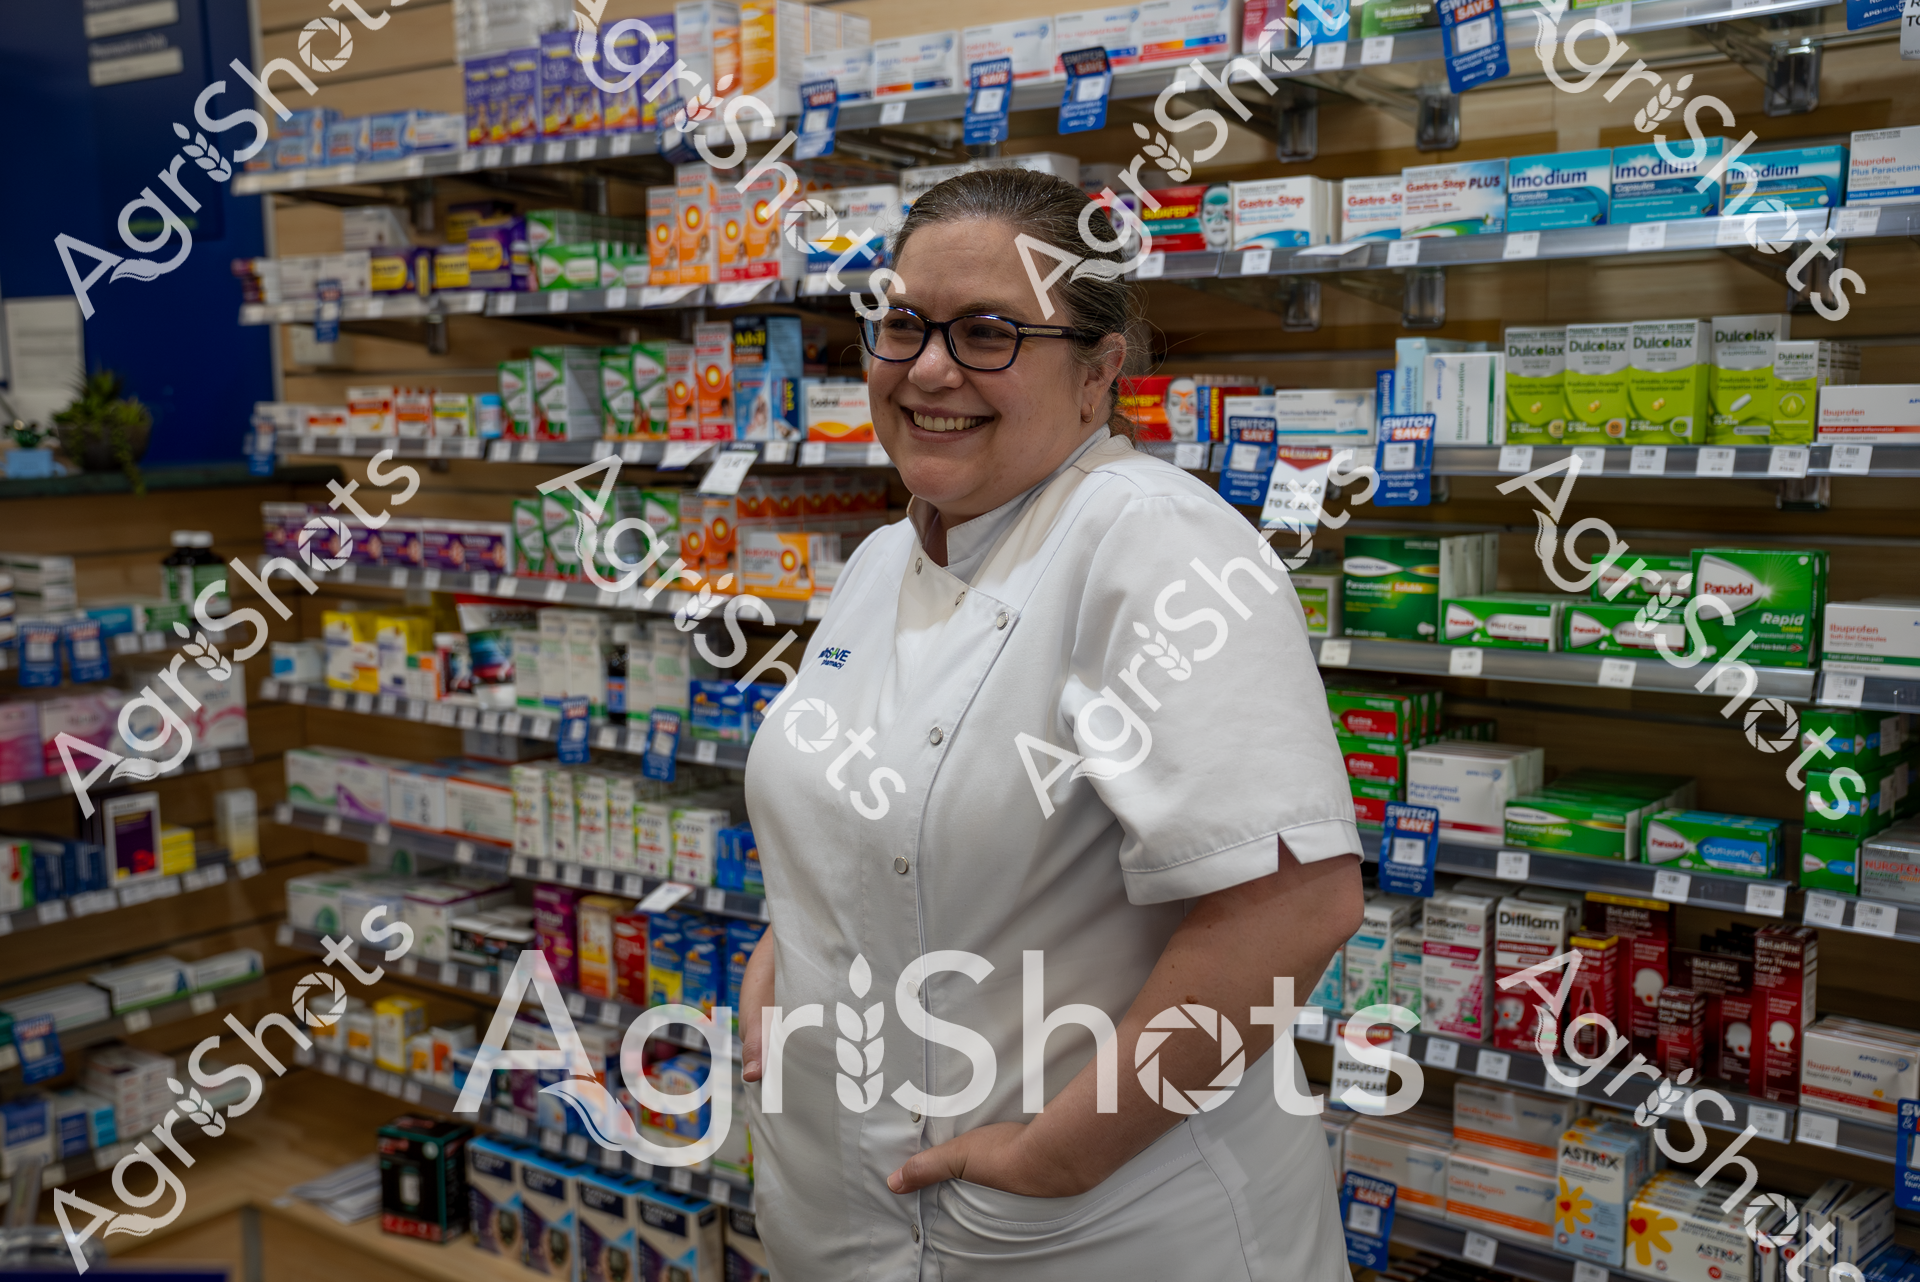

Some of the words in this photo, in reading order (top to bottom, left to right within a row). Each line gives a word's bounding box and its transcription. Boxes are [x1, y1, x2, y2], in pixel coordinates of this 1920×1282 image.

[1456, 0, 1493, 21] SAVE
[1063, 50, 1105, 66] SWITCH
[972, 59, 1010, 77] SWITCH
[1075, 61, 1105, 74] SAVE
[980, 73, 1008, 87] SAVE
[802, 80, 837, 98] SWITCH
[810, 92, 836, 107] SAVE
[1615, 157, 1697, 179] Imodium
[1852, 155, 1896, 167] Ibuprofen
[1511, 167, 1588, 189] Imodium
[1732, 164, 1799, 181] Imodium
[1851, 167, 1870, 177] Plus
[1406, 179, 1466, 193] Gastro-Stop
[1468, 174, 1500, 190] PLUS
[1615, 181, 1655, 193] Capsules
[1239, 195, 1305, 210] Gastro-Stop
[1511, 191, 1548, 202] Capsules
[1633, 336, 1692, 350] Dulcolax
[1714, 328, 1775, 343] Dulcolax
[1509, 343, 1565, 358] Dulcolax
[1569, 339, 1626, 353] Dulcolax
[1778, 351, 1814, 361] Dulcolax
[1823, 408, 1865, 418] Ibuprofen
[1230, 418, 1276, 431] SWITCH
[1382, 415, 1435, 429] SWITCH
[1241, 430, 1272, 442] SAVE
[1394, 427, 1428, 440] SAVE
[1269, 498, 1281, 508] TO
[1345, 579, 1392, 591] Paracetamol
[1394, 582, 1423, 593] Soluble
[1704, 581, 1754, 596] Panadol
[1760, 612, 1805, 627] Rapid
[1507, 623, 1527, 632] Caps
[1573, 625, 1601, 635] Panadol
[1829, 623, 1879, 636] Ibuprofen
[1347, 715, 1373, 726] Extra
[1349, 758, 1374, 770] Extra
[1386, 805, 1436, 821] SWITCH
[1398, 817, 1432, 833] SAVE
[1651, 837, 1685, 849] Panadol
[1426, 915, 1467, 931] Difflam
[1499, 911, 1559, 931] Difflam
[1756, 936, 1801, 954] Betadine
[1692, 957, 1739, 973] Betadine
[1337, 1061, 1386, 1074] REDUCED
[1806, 1059, 1851, 1076] Ibuprofen
[1852, 1069, 1878, 1083] Melts
[1336, 1078, 1351, 1091] TO
[1353, 1079, 1388, 1092] CLEAR
[1562, 1144, 1619, 1172] ASTRIX
[1346, 1172, 1396, 1195] SWITCH
[1355, 1187, 1391, 1207] SAVE
[1696, 1241, 1745, 1266] ASTRIX
